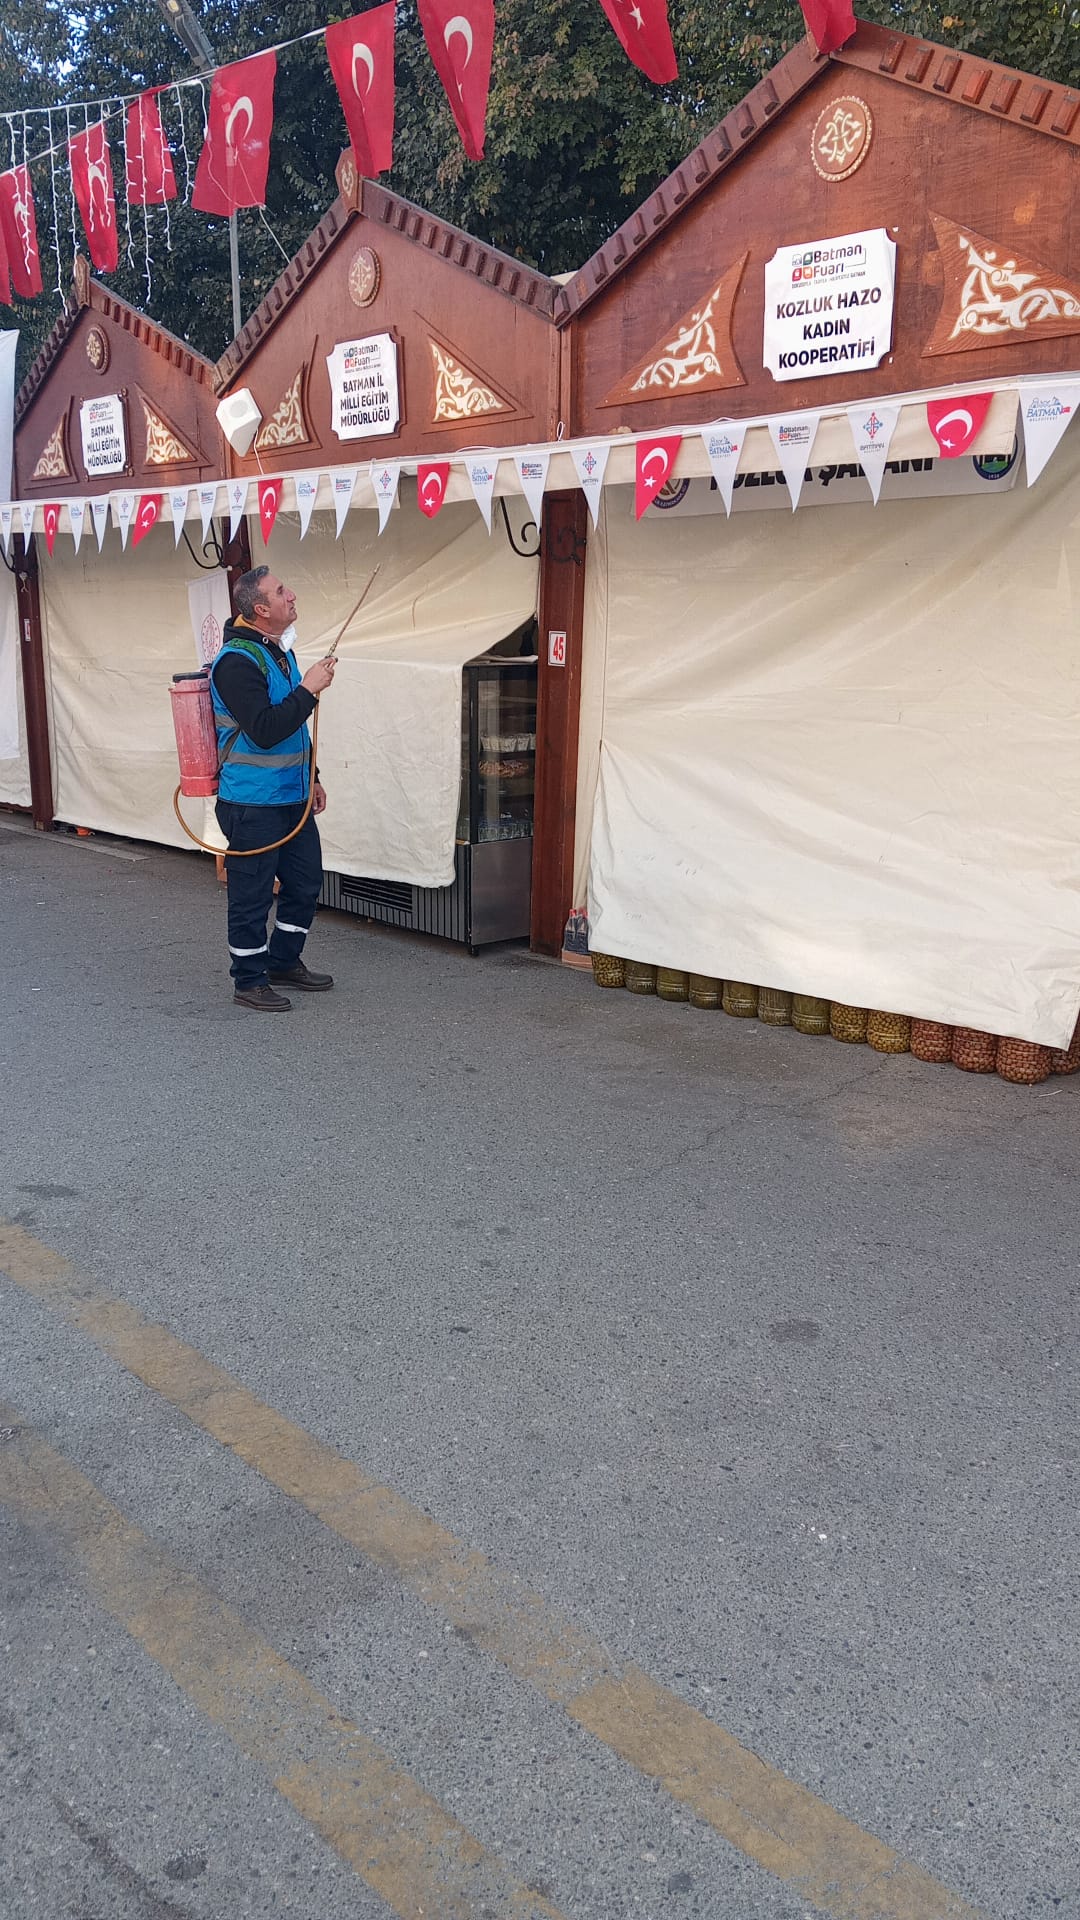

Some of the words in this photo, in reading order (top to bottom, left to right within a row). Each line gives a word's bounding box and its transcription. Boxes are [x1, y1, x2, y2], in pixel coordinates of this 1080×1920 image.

[814, 244, 862, 263] Batman
[814, 263, 844, 278] Fuarı
[776, 295, 833, 320] KOZLUK
[837, 287, 882, 309] HAZO
[803, 318, 850, 341] KADIN
[354, 344, 378, 356] Batman
[778, 336, 875, 369] KOOPERATİFİ
[343, 376, 375, 393] BATMAN
[377, 372, 384, 387] İL
[340, 394, 360, 411] MİLLİ
[361, 389, 389, 407] EĞİTİM
[341, 407, 390, 427] MÜDÜRLÜĞÜ
[1026, 405, 1063, 418] BATMAN
[91, 425, 113, 437] BATMAN
[87, 439, 100, 453] MİLLİ
[102, 437, 120, 450] EĞİTİM
[88, 451, 121, 466] MÜDÜRLÜĞÜ
[553, 636, 564, 661] 45
